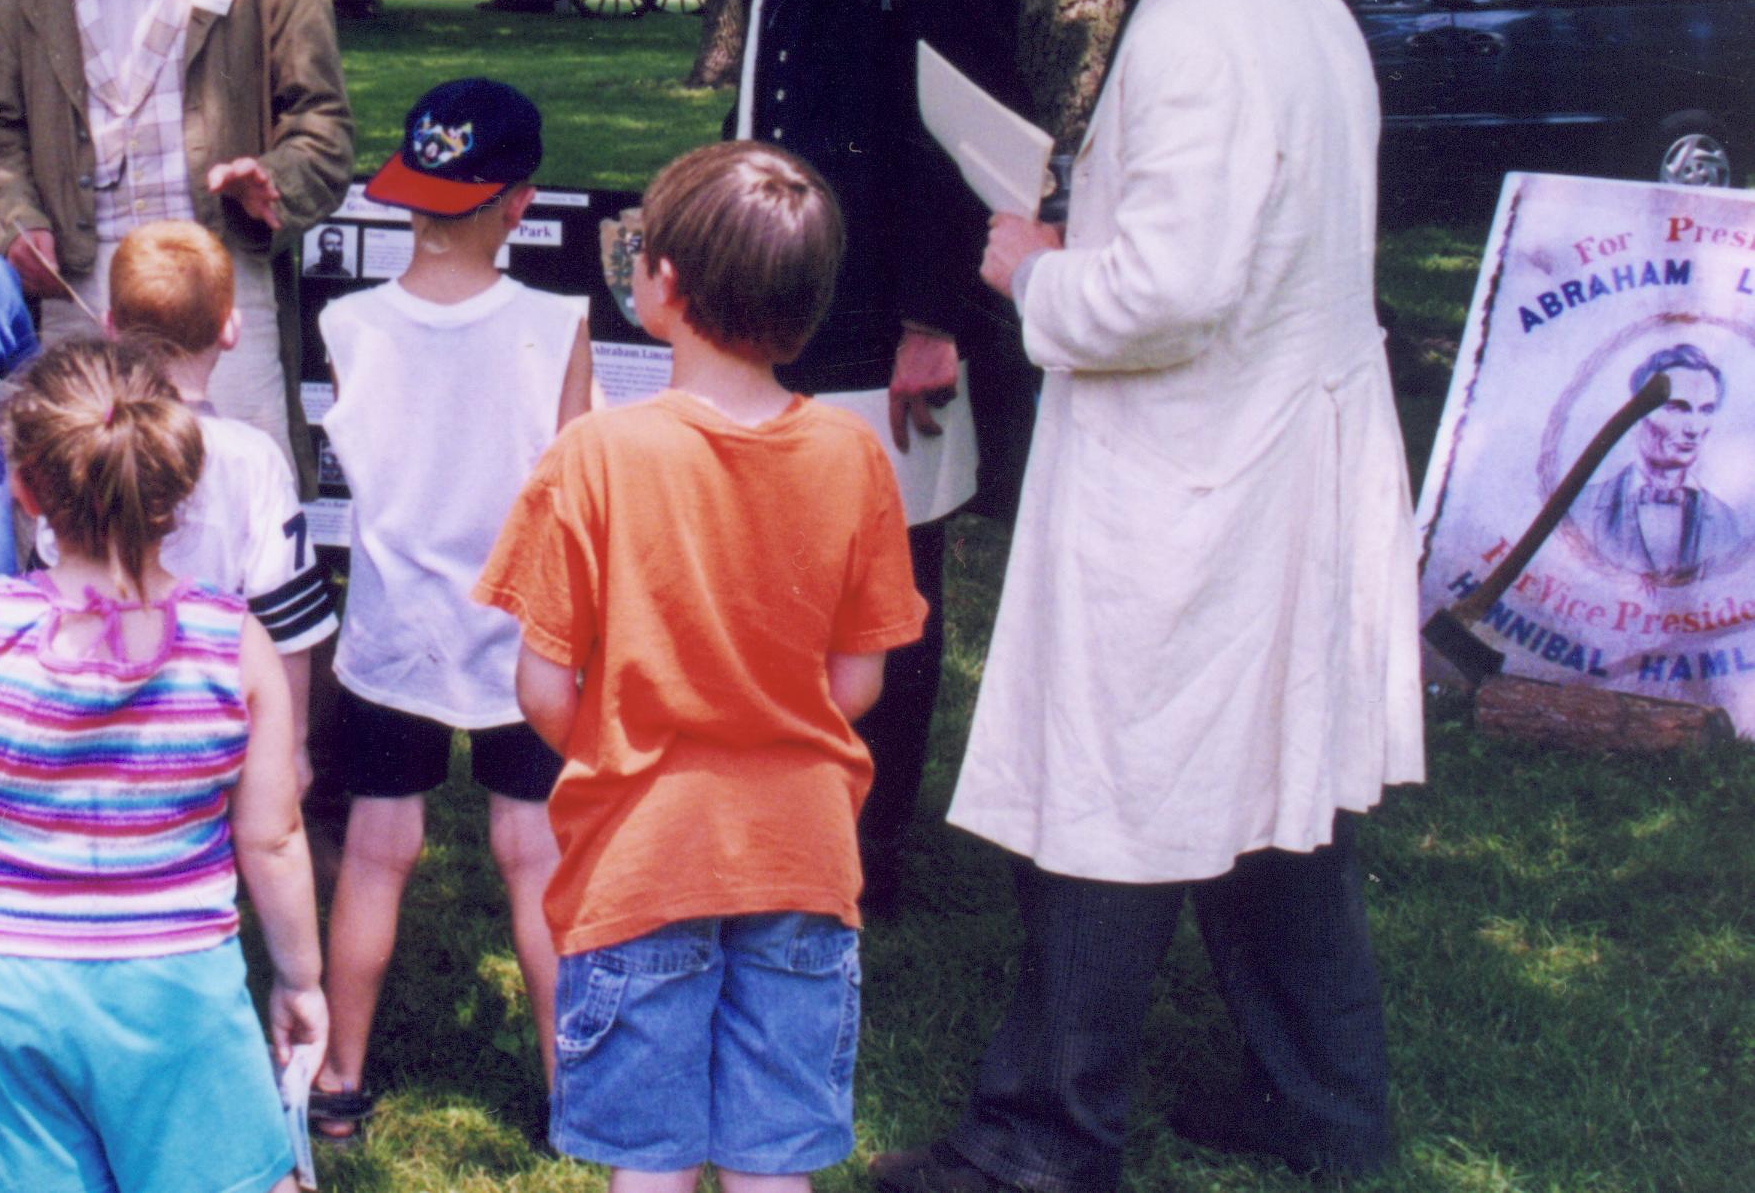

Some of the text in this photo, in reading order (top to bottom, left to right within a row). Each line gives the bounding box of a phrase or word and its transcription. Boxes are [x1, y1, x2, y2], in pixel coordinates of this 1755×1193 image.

[519, 225, 552, 238] Park
[1573, 232, 1633, 266] For
[1518, 258, 1692, 334] ABRAHAM
[1481, 536, 1541, 595] Fr
[1540, 574, 1607, 627] Vice
[1447, 570, 1609, 677] HNNIBAL
